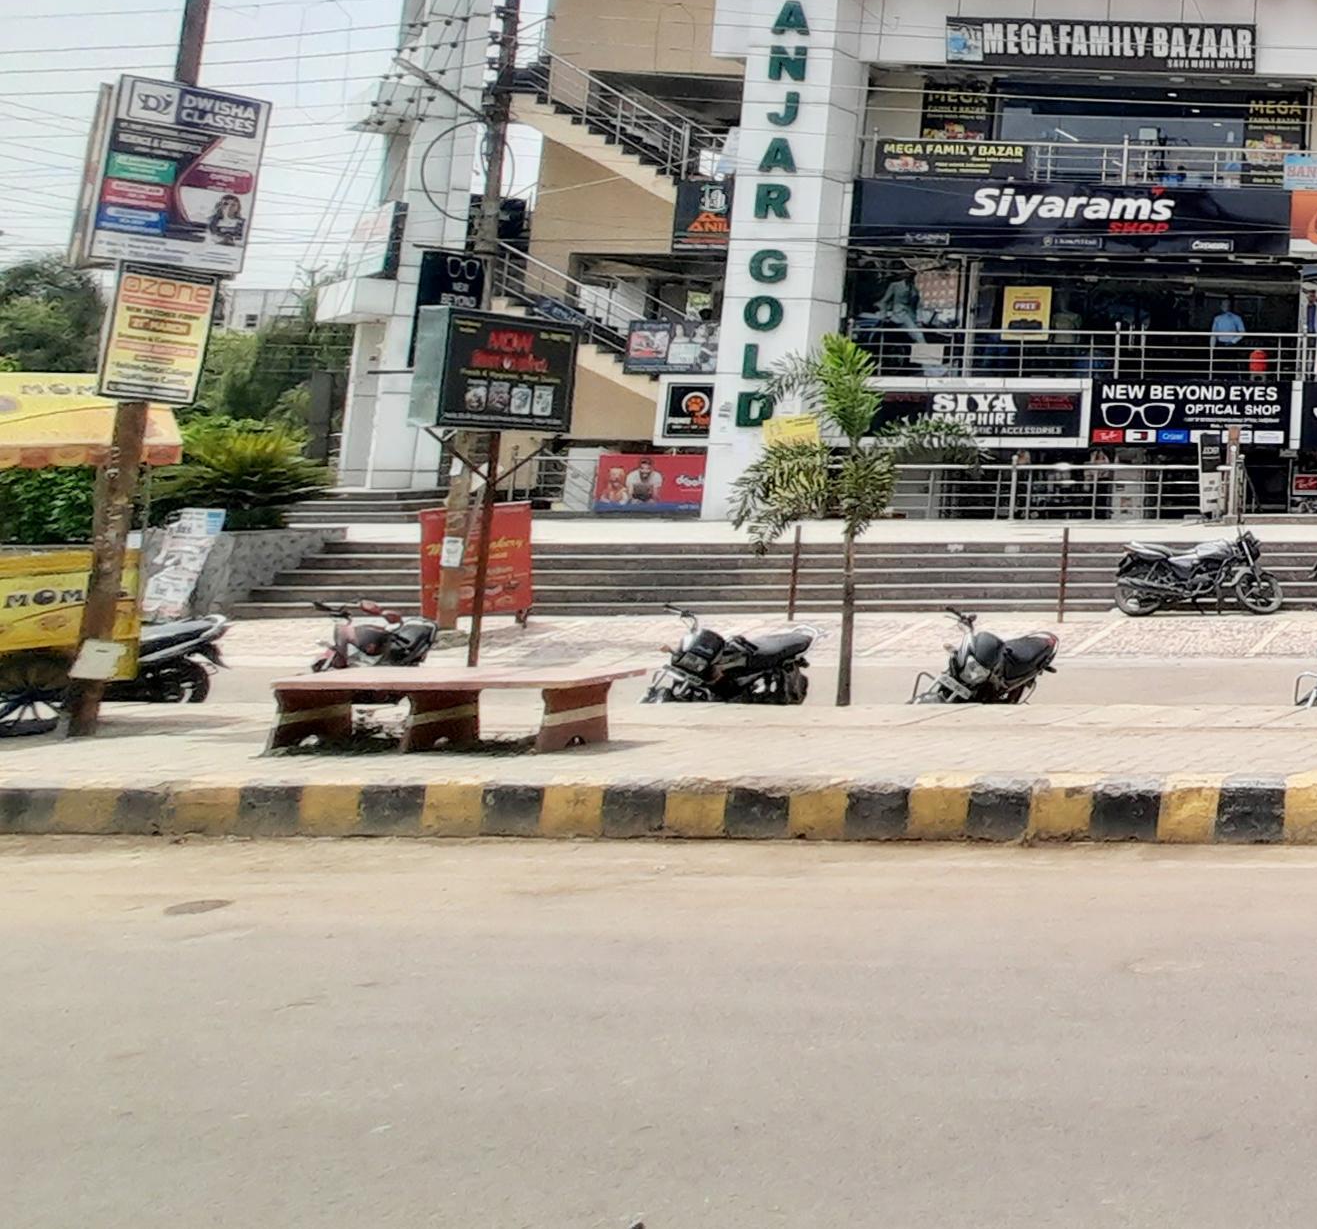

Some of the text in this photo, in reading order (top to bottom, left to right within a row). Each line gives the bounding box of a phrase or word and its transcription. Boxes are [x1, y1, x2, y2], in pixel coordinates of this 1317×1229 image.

[982, 22, 1254, 59] MEGA FAMILY BAZAAR
[182, 94, 257, 121] DWISHA
[1249, 99, 1302, 115] MEGA
[180, 109, 255, 133] CLASSES
[883, 143, 1024, 158] MEGA FAMILY BAZAR
[1107, 222, 1170, 235] SHOP
[440, 293, 477, 308] BEYOND
[734, 249, 789, 428] GOLD
[1102, 384, 1278, 401] NEW BEYOND EYES
[932, 393, 1018, 413] SIYA
[1185, 404, 1281, 416] OPTICAL SHOP
[1000, 426, 1062, 435] ACCESSORIES
